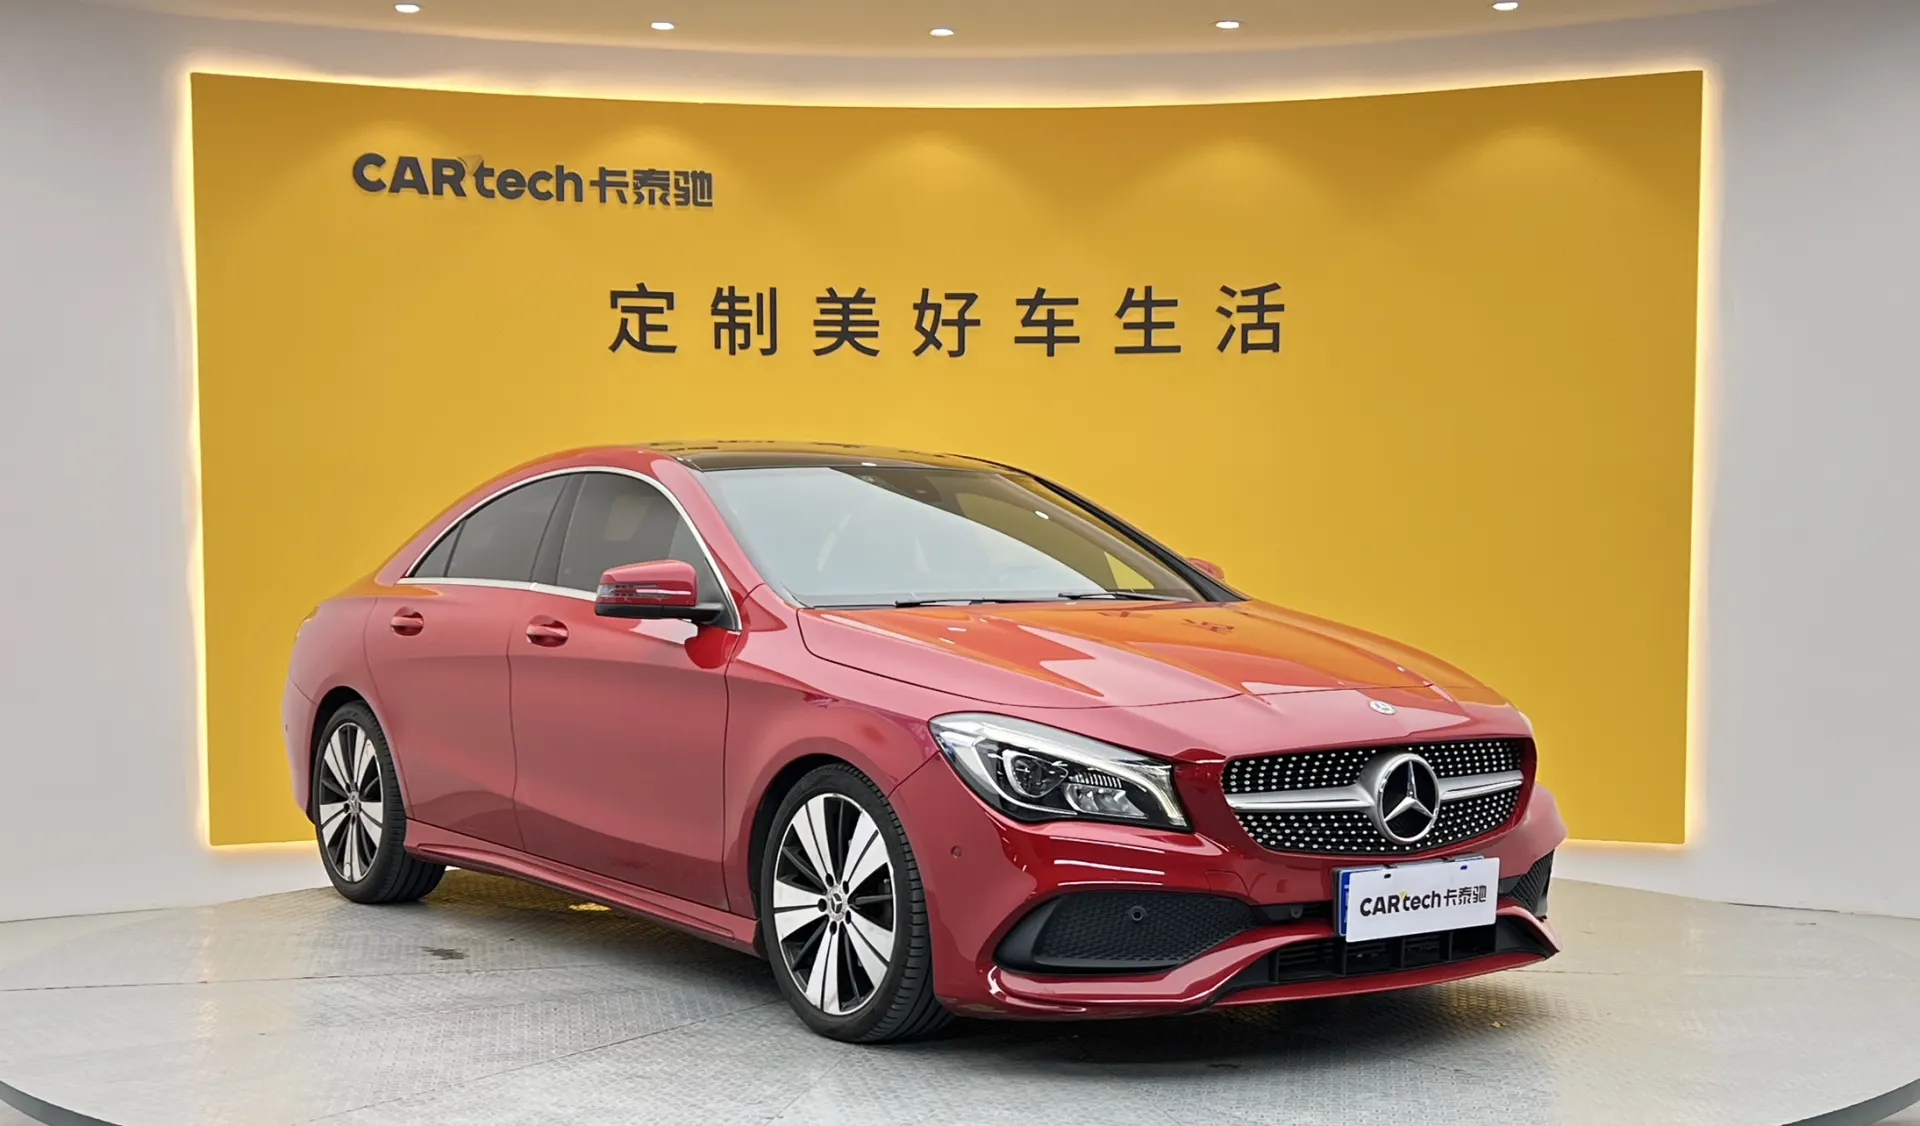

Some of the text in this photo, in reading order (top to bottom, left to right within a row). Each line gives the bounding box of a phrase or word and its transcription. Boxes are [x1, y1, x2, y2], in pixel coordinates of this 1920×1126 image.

[352, 152, 713, 207] CARtech 卡泰驰
[608, 282, 1286, 357] 定制美好车生活
[1360, 890, 1441, 917] CARtech
[1443, 885, 1487, 907] 卡泰驰
